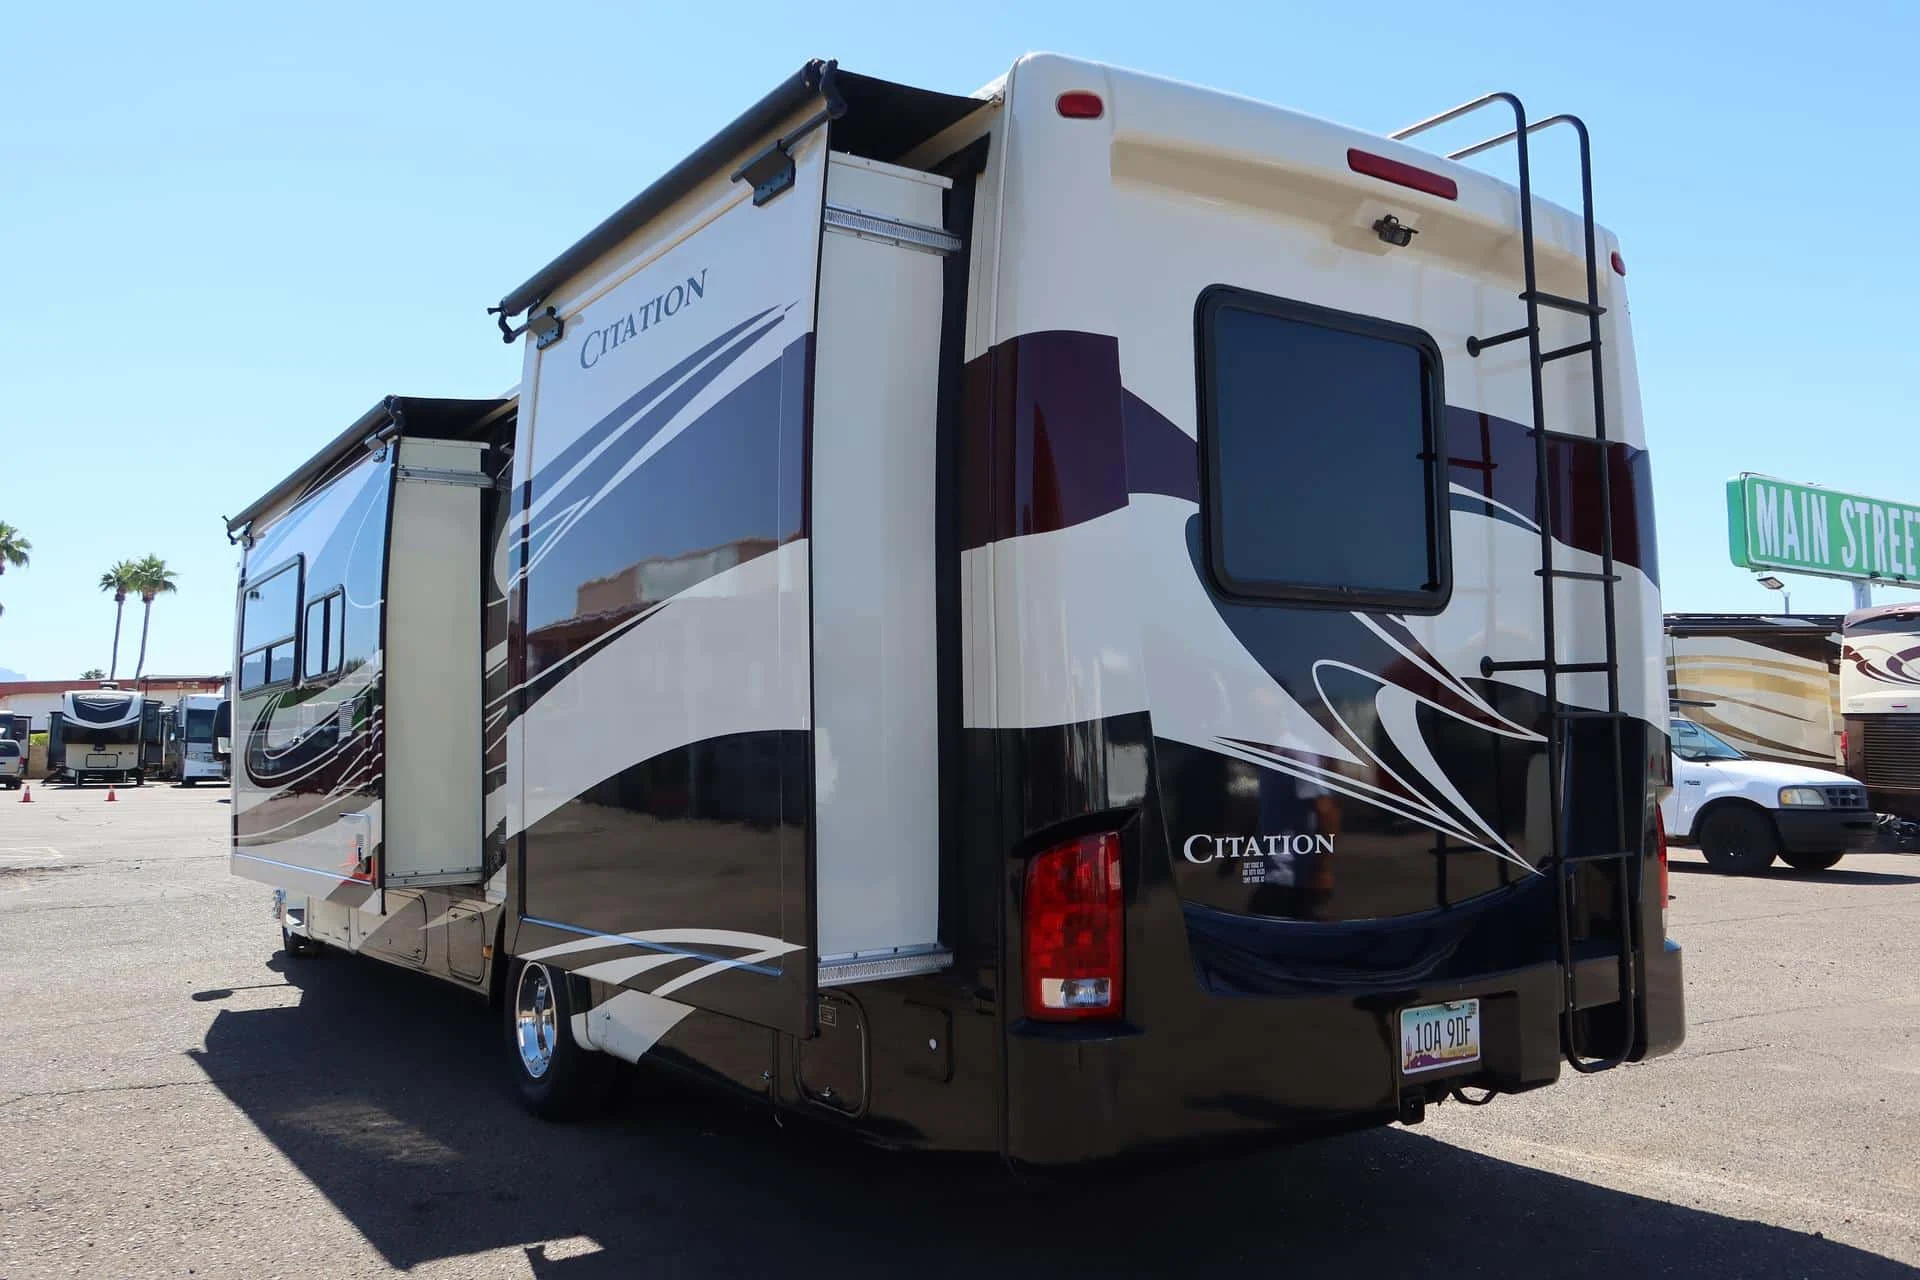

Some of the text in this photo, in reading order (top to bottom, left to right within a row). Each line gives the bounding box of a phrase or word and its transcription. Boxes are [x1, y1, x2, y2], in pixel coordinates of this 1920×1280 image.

[580, 268, 708, 369] CITATION
[1755, 484, 1830, 564] MAIN
[1183, 833, 1335, 864] CITATION
[1447, 1016, 1472, 1048] 9DF
